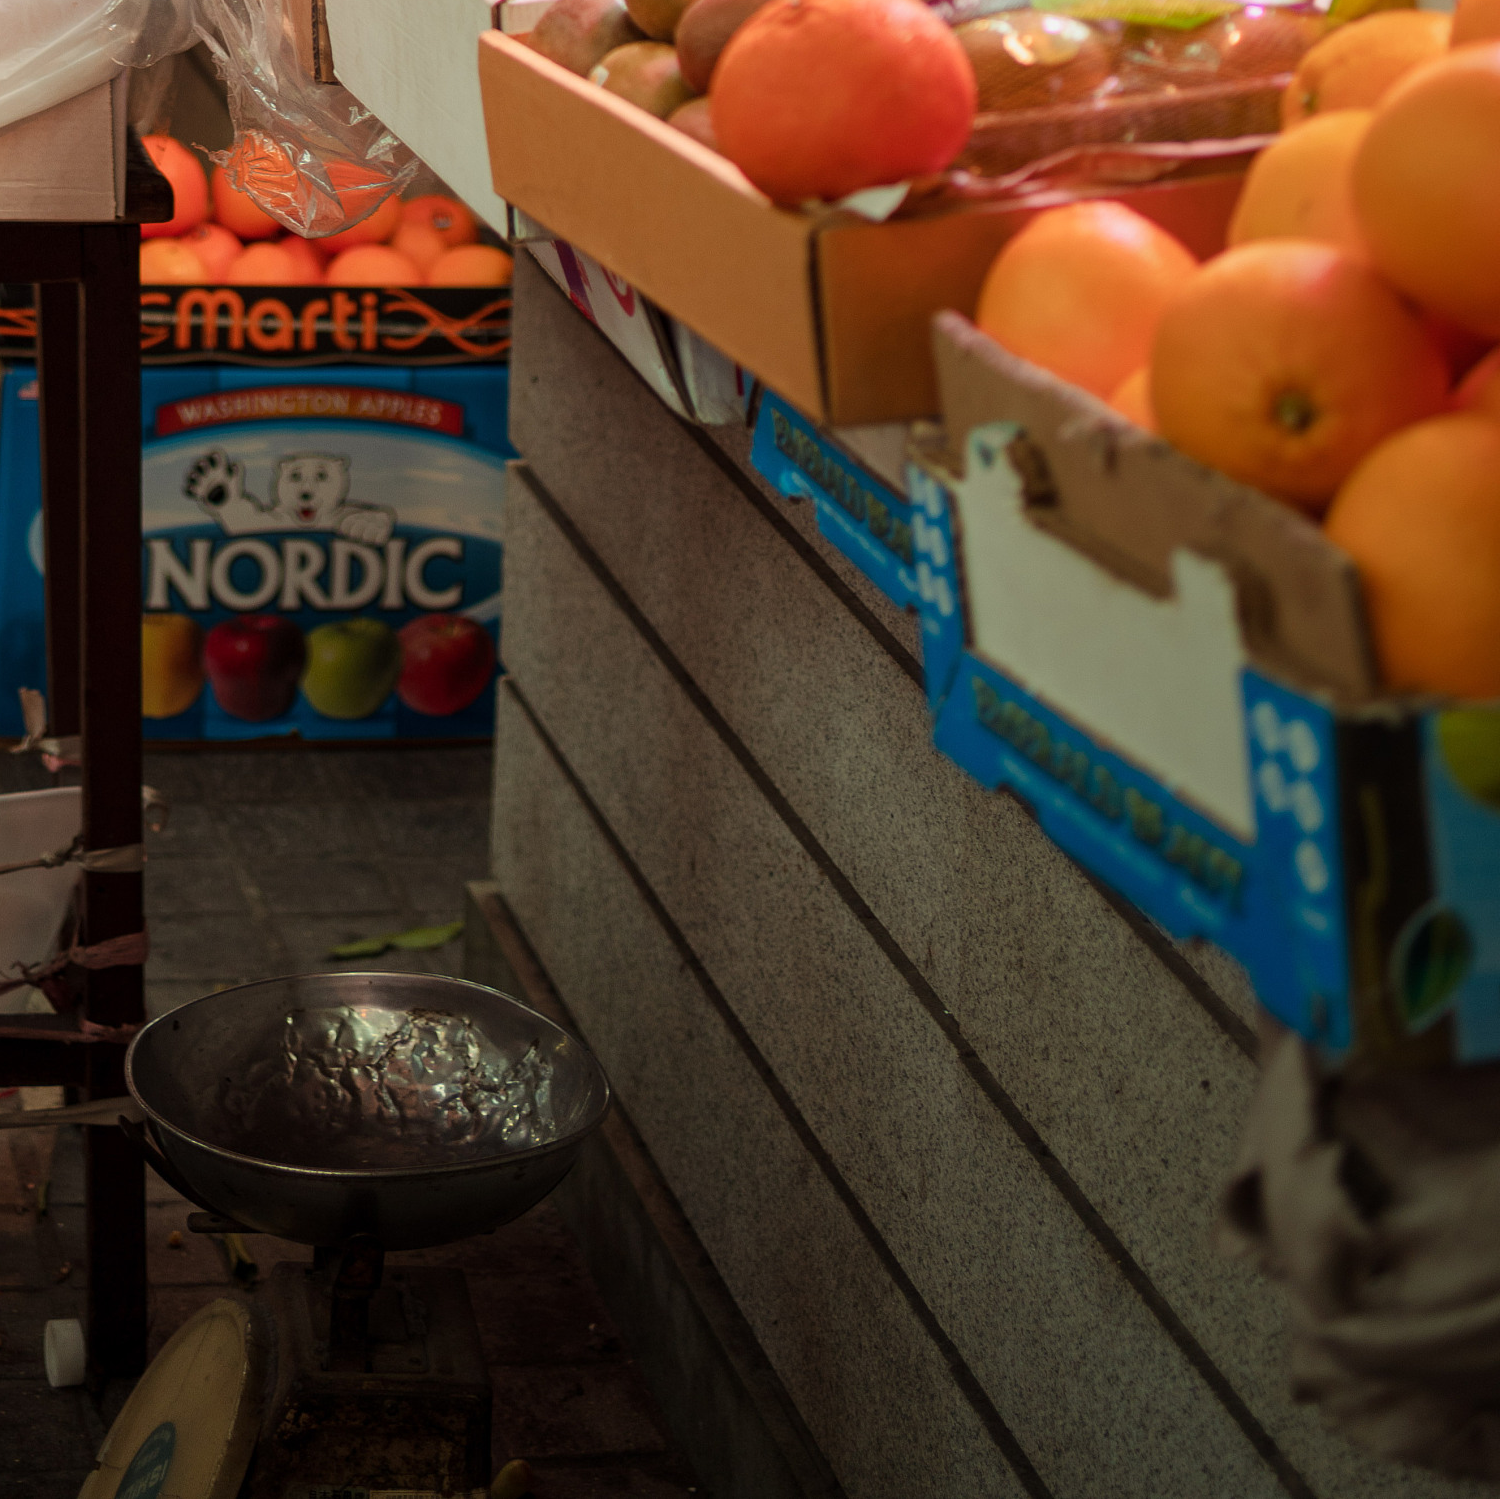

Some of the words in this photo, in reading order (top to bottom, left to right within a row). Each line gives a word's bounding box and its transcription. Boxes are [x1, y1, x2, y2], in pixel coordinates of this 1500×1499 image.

[176, 392, 351, 426] WASHINGTON
[357, 396, 442, 427] APPLES
[146, 537, 464, 611] NORDIC
